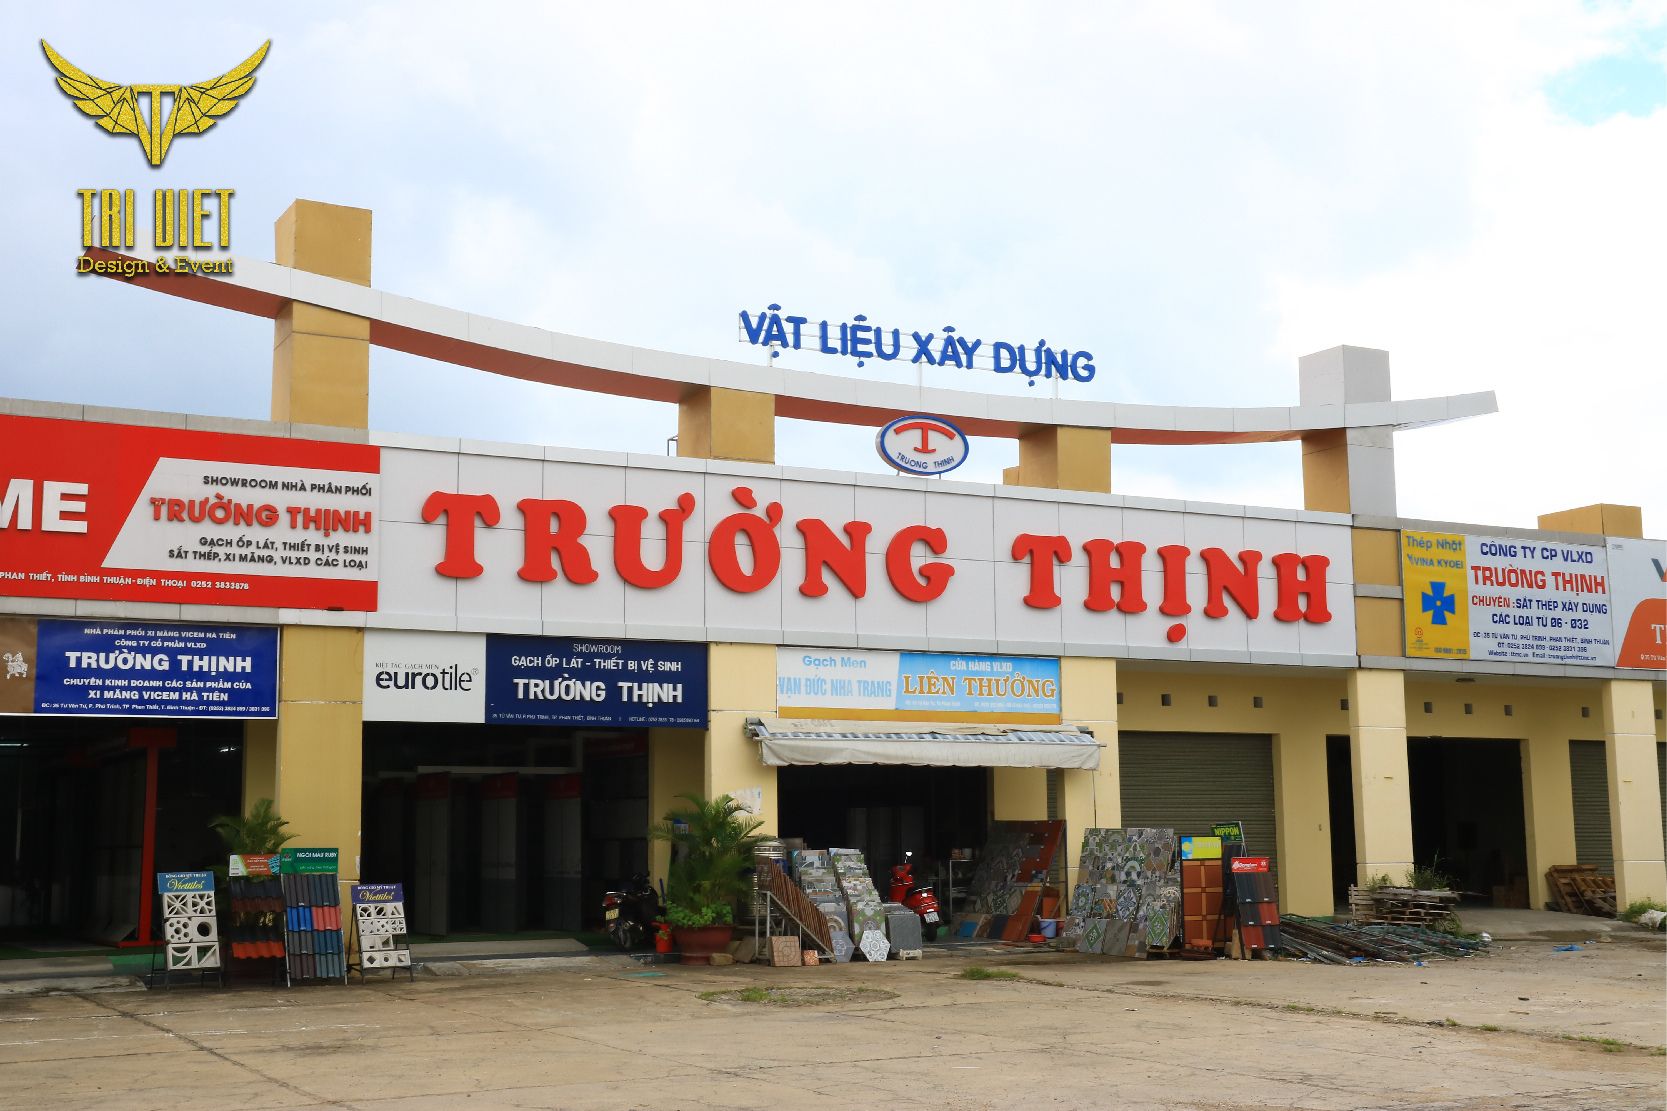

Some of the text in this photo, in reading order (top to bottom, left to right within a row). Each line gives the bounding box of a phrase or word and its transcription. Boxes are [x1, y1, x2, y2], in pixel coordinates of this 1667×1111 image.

[740, 303, 1097, 388] VẬT LIỆU XÂY DỰNG
[895, 452, 955, 470] TRUONG THINH
[203, 475, 372, 497] SHOWROOM NHÀ PHÂN PHỐI
[149, 492, 372, 538] TRƯỜNG THỊNH
[199, 534, 369, 556] GẠCH ỐP LÁT, THIẾT BỊ VỆ SINH
[1480, 540, 1594, 564] CÔNG TY CP VLXD
[168, 545, 368, 571] SẮT THÉP, XI MĂNG, VLXD CÁC LOẠI
[421, 486, 1333, 644] TRƯỜNG THỊNH
[160, 578, 187, 589] THOẠI
[191, 580, 212, 589] 0252
[1470, 563, 1606, 597] TRƯỜNG THỊNH
[1535, 598, 1559, 611] THÉP
[1561, 600, 1580, 613] XÂY
[1491, 612, 1511, 625] CÁC
[115, 638, 138, 647] CÔNG
[186, 641, 207, 649] VLXD
[572, 643, 622, 654] SHOWROOM
[64, 648, 252, 676] TRƯỜNG THỊNH
[511, 656, 542, 669] GẠCH
[544, 654, 560, 668] ỐP
[562, 656, 584, 669] LÁT
[593, 656, 625, 670] THIẾT
[627, 660, 639, 673] BỊ
[640, 658, 655, 674] VỆ
[657, 660, 682, 672] SINH
[802, 655, 868, 670] Gạch Men
[950, 657, 1013, 673] CỬA HÀNG VLXD
[63, 676, 103, 686] CHUYÊN
[105, 679, 129, 687] KINH
[130, 679, 163, 688] DOANH
[164, 679, 184, 688] CÁC
[375, 663, 473, 691] eurotile
[804, 674, 827, 696] ĐỨC
[830, 679, 854, 697] NHA
[855, 679, 892, 698] TRANG
[901, 670, 1057, 699] LIÊN THƯỞNG
[87, 690, 101, 699] XI
[103, 688, 140, 700] MĂNG
[142, 691, 180, 700] VICEM
[201, 690, 229, 702] TIÊN
[512, 673, 684, 708] TRƯỜNG THỊNH
[1214, 826, 1240, 837] NIPPON
